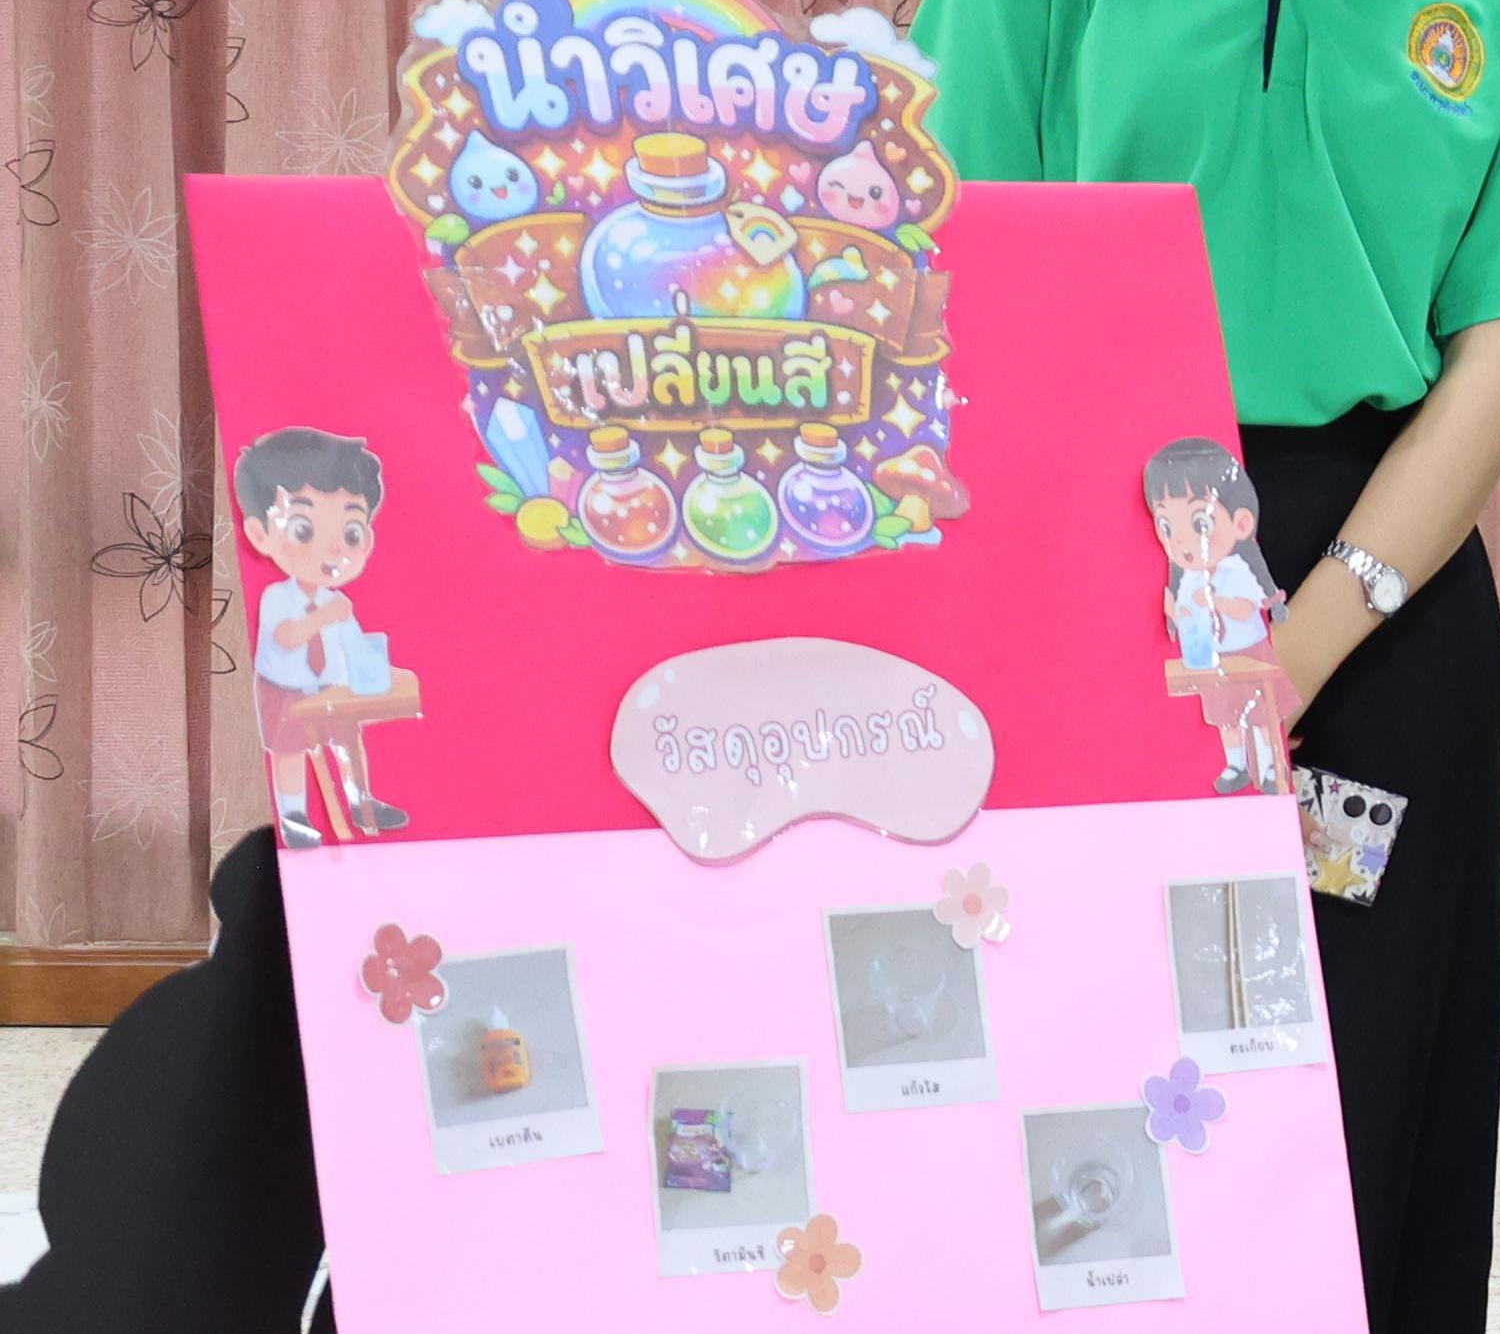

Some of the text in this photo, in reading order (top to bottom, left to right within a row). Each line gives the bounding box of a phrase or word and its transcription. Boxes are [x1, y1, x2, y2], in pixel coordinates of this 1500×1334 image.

[575, 290, 833, 410] เปลี่ยนสี
[653, 682, 945, 786] วัสดุอุปกรณ์
